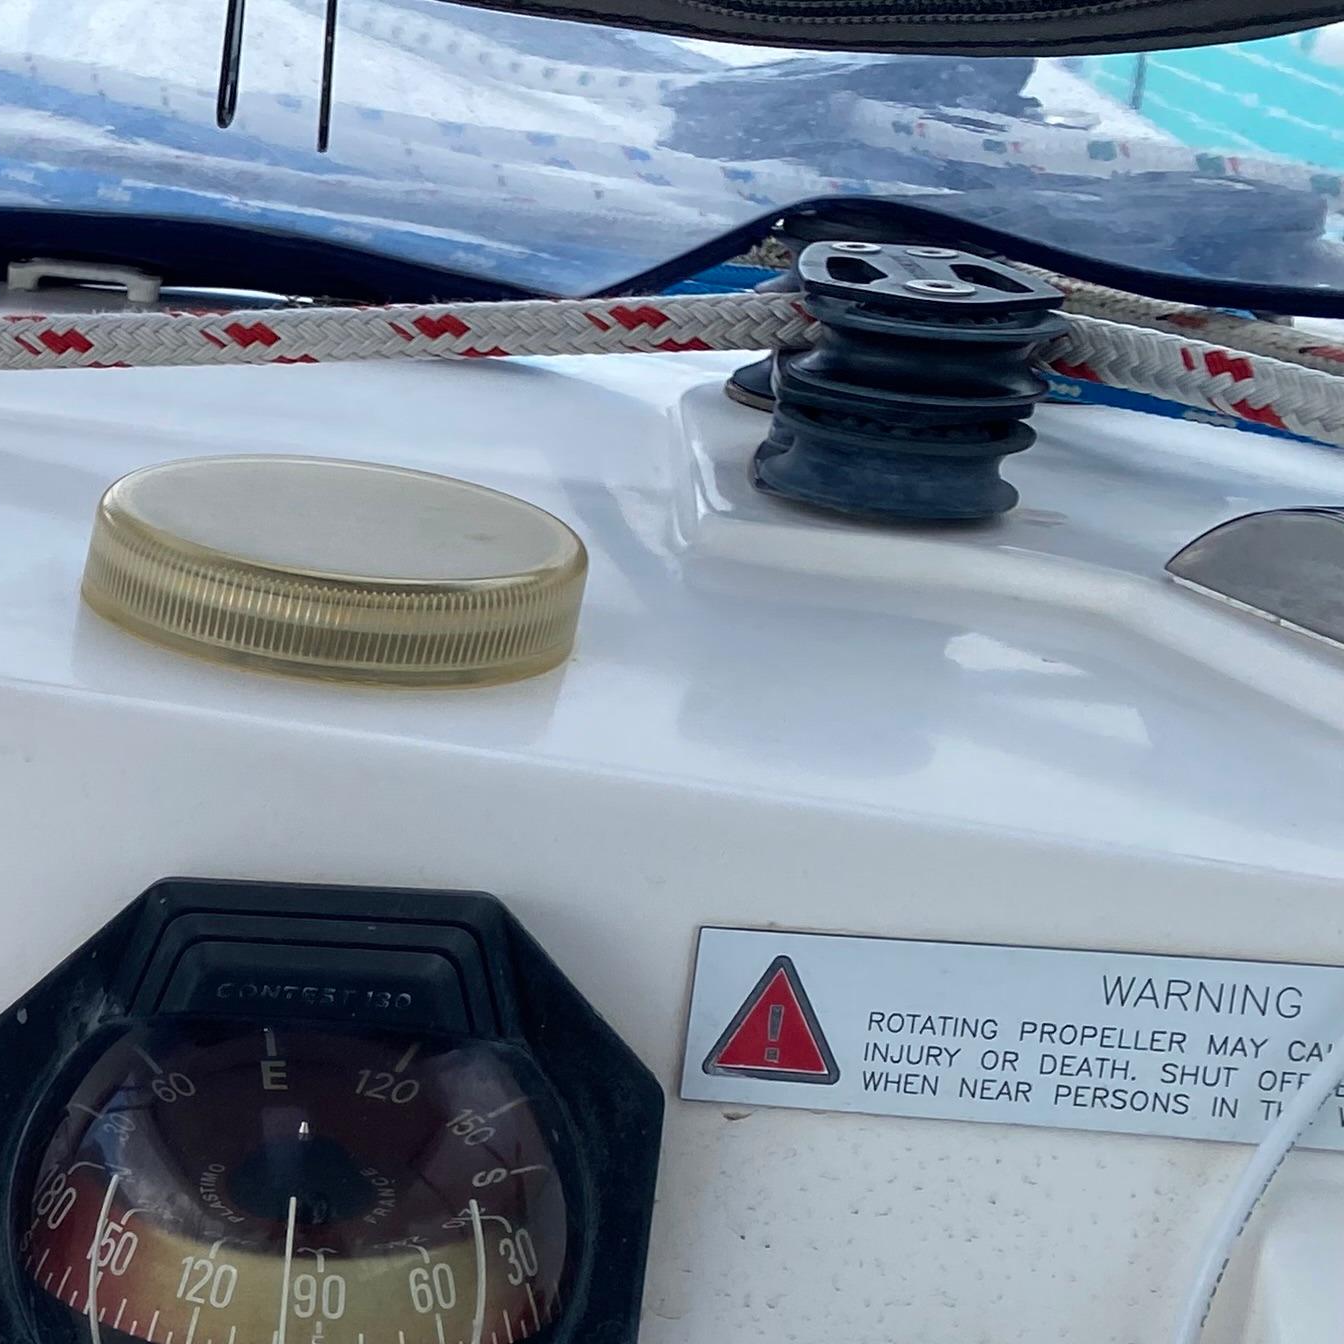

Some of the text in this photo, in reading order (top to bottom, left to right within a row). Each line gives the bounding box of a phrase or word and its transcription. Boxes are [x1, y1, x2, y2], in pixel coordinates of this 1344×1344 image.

[1103, 975, 1303, 1018] WARNING
[868, 1011, 998, 1040] ROTATING
[1019, 1021, 1187, 1053] PROPELLER
[1208, 1034, 1269, 1059] MAY
[151, 1072, 196, 1103] 60
[261, 1060, 288, 1090] E
[355, 1069, 419, 1103] 120
[864, 1042, 961, 1067] INJURY
[980, 1050, 1019, 1072] OR
[1040, 1054, 1137, 1081] DEATH.
[1160, 1063, 1239, 1088] SHUT
[1258, 1070, 1312, 1093] OFF
[862, 1070, 939, 1096] WHEN
[959, 1077, 1032, 1103] NEAR
[1054, 1084, 1190, 1115] PERSONS
[1212, 1096, 1238, 1119] IN
[446, 1109, 496, 1145] 150
[32, 1164, 77, 1230] 180
[472, 1168, 507, 1187] S
[499, 1228, 538, 1286] 30
[176, 1256, 238, 1309] 120
[294, 1274, 346, 1320] 90
[409, 1263, 456, 1314] 60
